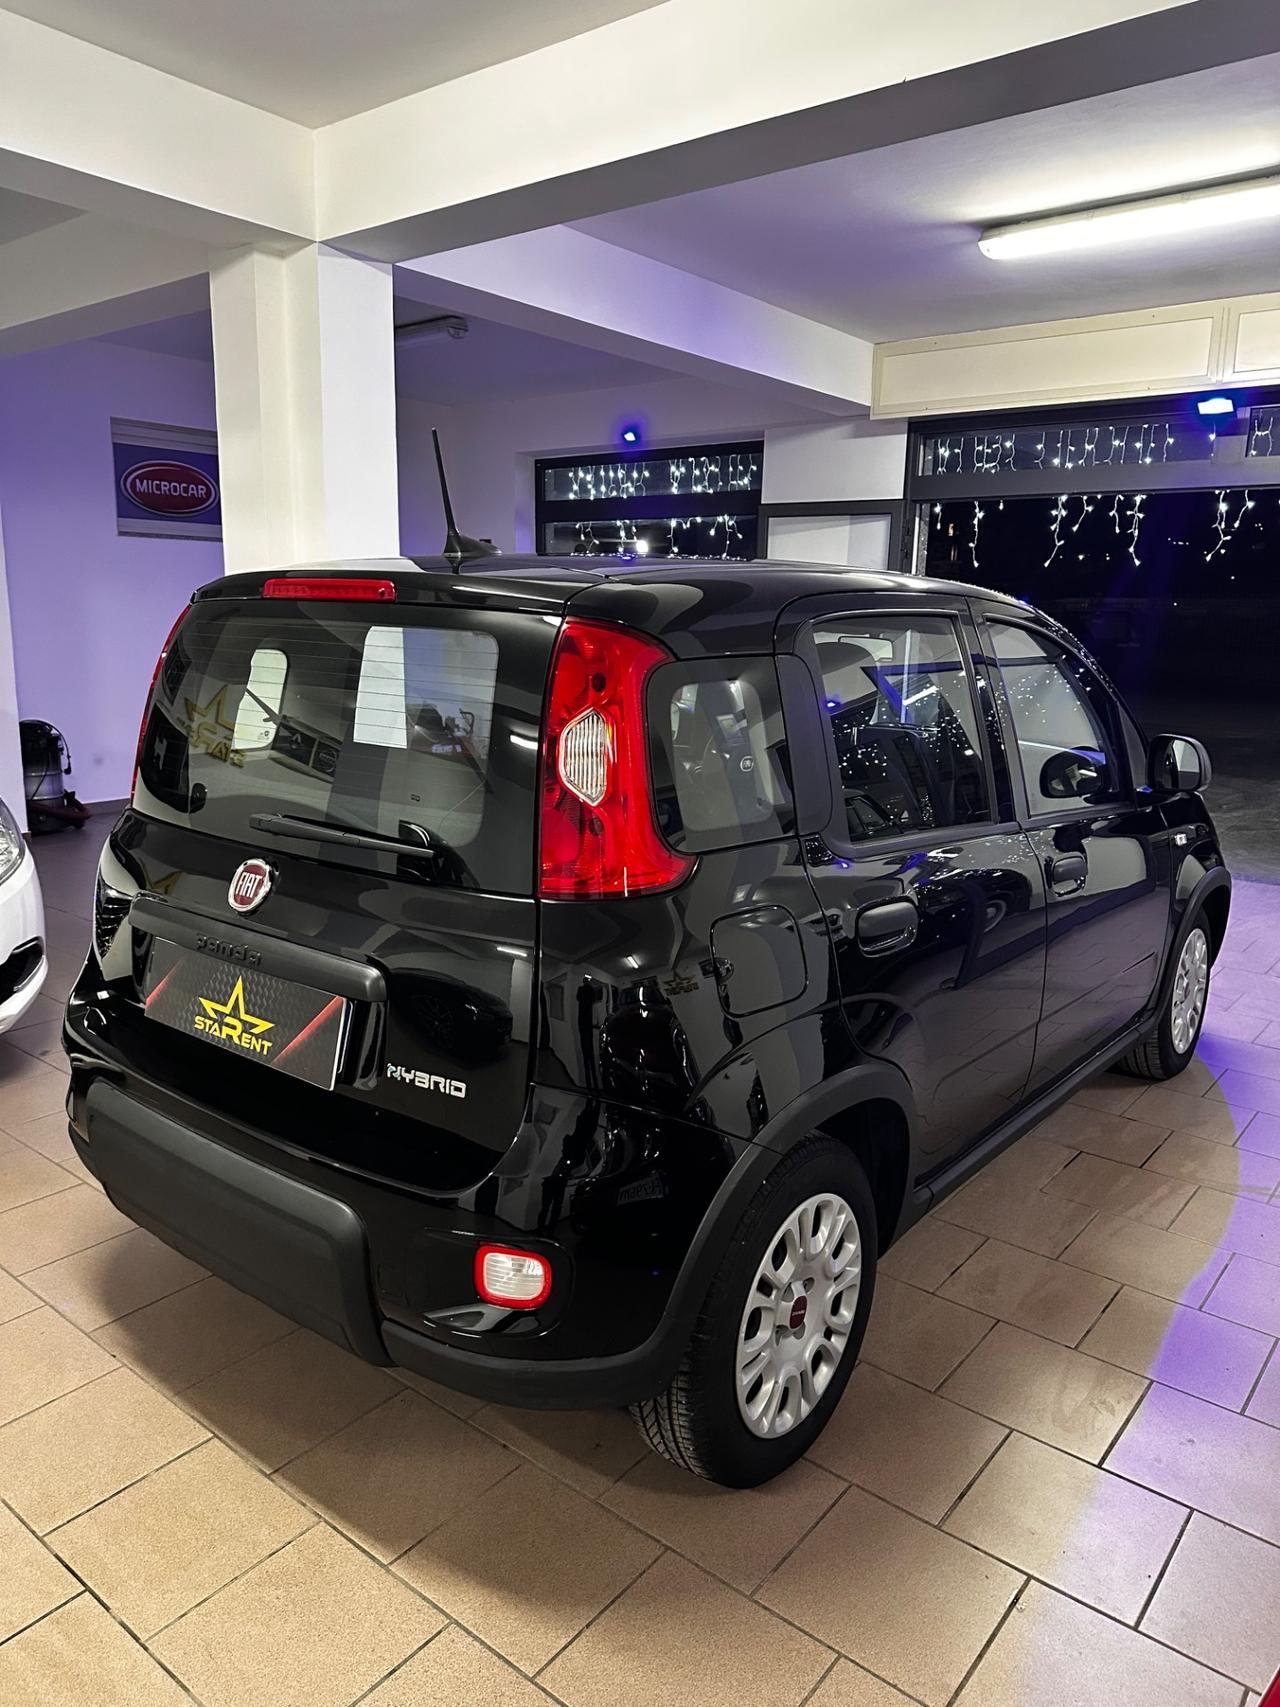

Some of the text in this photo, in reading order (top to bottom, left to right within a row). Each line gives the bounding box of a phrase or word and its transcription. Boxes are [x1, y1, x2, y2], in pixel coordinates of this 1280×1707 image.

[135, 478, 207, 499] MICROCAR
[235, 871, 262, 899] FIAT
[196, 934, 261, 966] panda
[194, 1015, 273, 1056] STARENT
[386, 1063, 467, 1098] HYBRID
